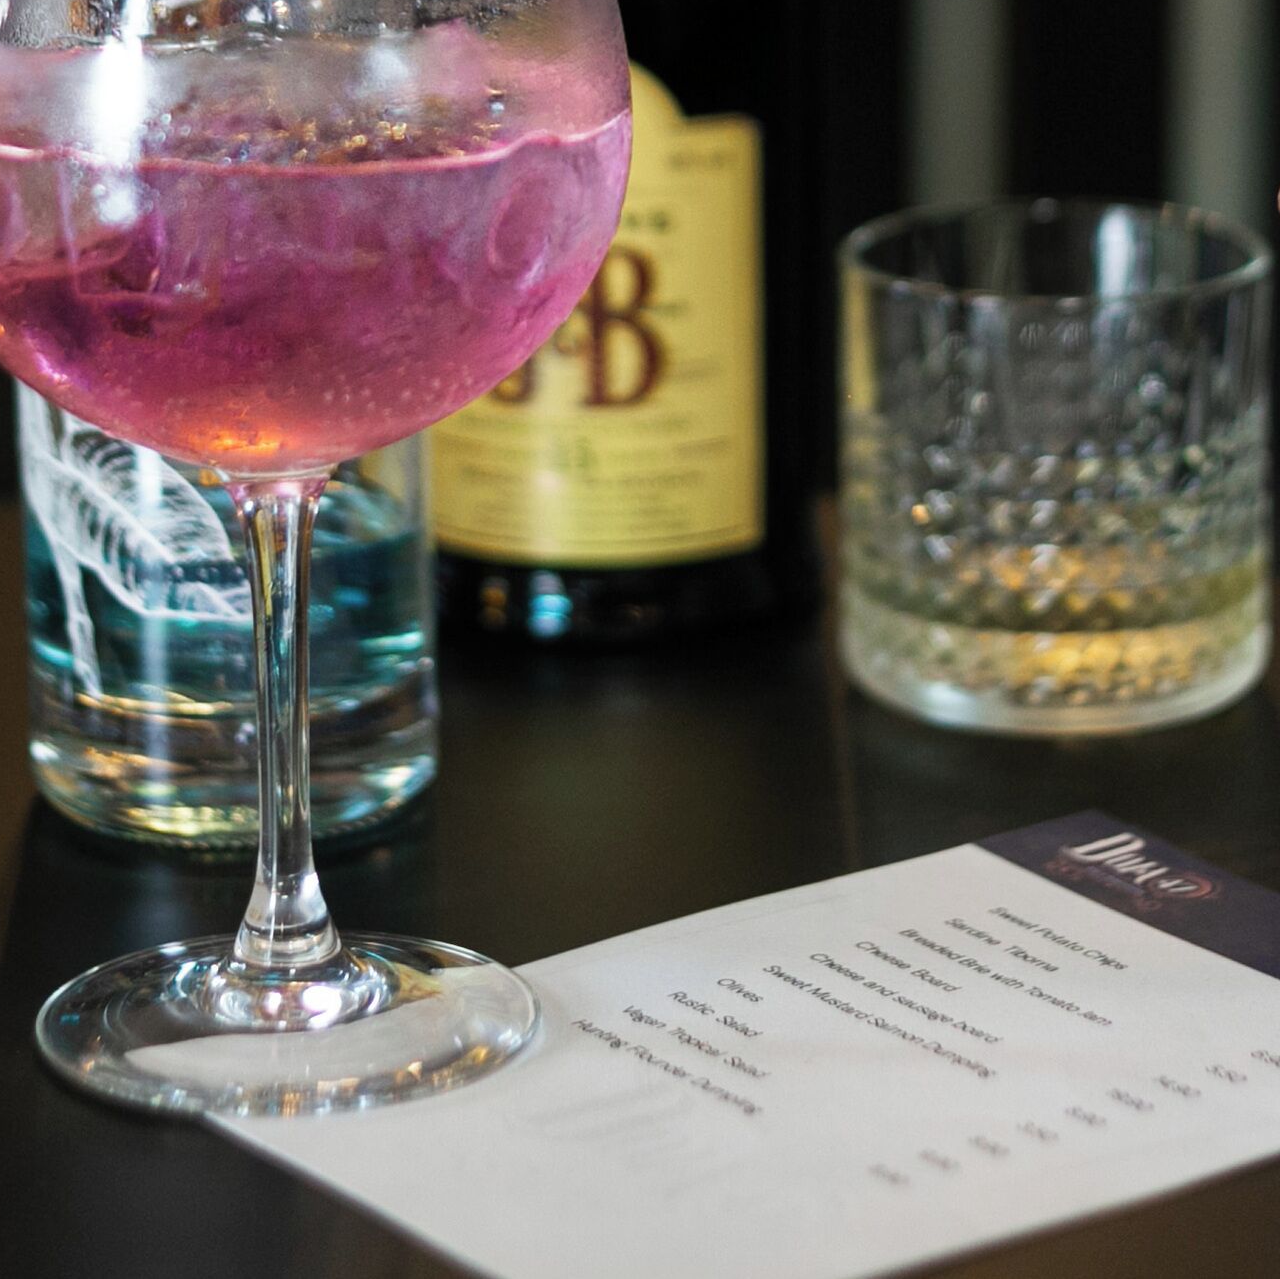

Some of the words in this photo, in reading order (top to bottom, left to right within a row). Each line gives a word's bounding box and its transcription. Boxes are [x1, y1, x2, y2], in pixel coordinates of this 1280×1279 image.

[945, 918, 1000, 945] Sardine
[989, 907, 1039, 930] Sweet
[1034, 928, 1084, 951] Potato
[1082, 950, 1127, 970] Chips
[717, 979, 763, 1002] Olives
[856, 942, 910, 969] Cheese
[910, 969, 961, 992] Board
[899, 929, 964, 960] Breaded
[958, 958, 991, 974] Brie
[990, 973, 1024, 989] with
[1025, 986, 1080, 1012] Tomato
[1077, 1011, 1112, 1026] Jam
[668, 991, 715, 1015] Rustic
[716, 1016, 763, 1038] Salad
[763, 965, 812, 989] Sweet
[807, 988, 872, 1019] Mustard
[867, 1018, 924, 1044] Salmon
[921, 1042, 995, 1079] Dumpling
[810, 954, 864, 981] Cheese
[862, 982, 898, 996] and
[892, 996, 953, 1023] sausage
[951, 1021, 1002, 1044] board
[572, 1019, 628, 1049] Hunting
[626, 1045, 690, 1078] Flounder
[623, 1006, 666, 1028] Vegan
[669, 1027, 726, 1057] Tropical
[723, 1057, 766, 1079] Salad
